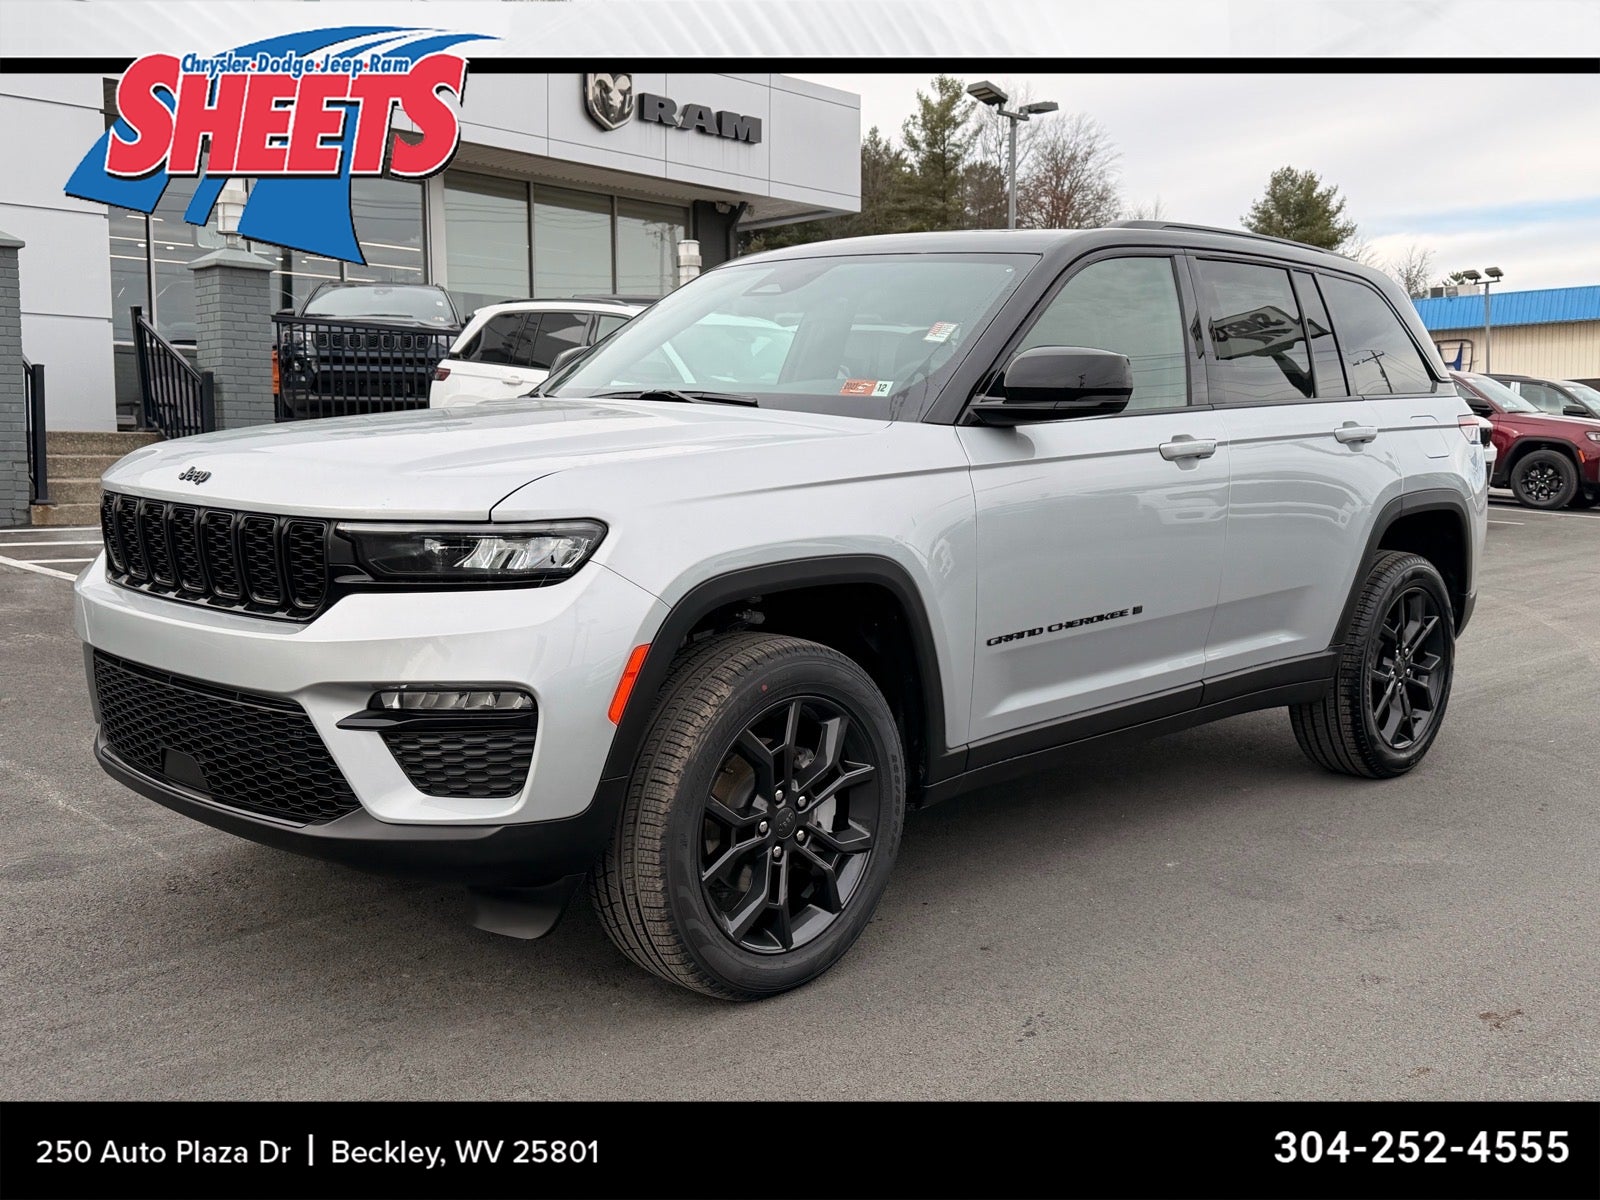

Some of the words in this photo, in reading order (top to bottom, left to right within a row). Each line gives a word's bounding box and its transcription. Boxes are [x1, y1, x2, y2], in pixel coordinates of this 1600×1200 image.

[637, 92, 763, 144] RAM
[178, 465, 212, 486] Jeep
[986, 626, 1044, 647] GRAND
[1047, 608, 1130, 633] CHEROKEE
